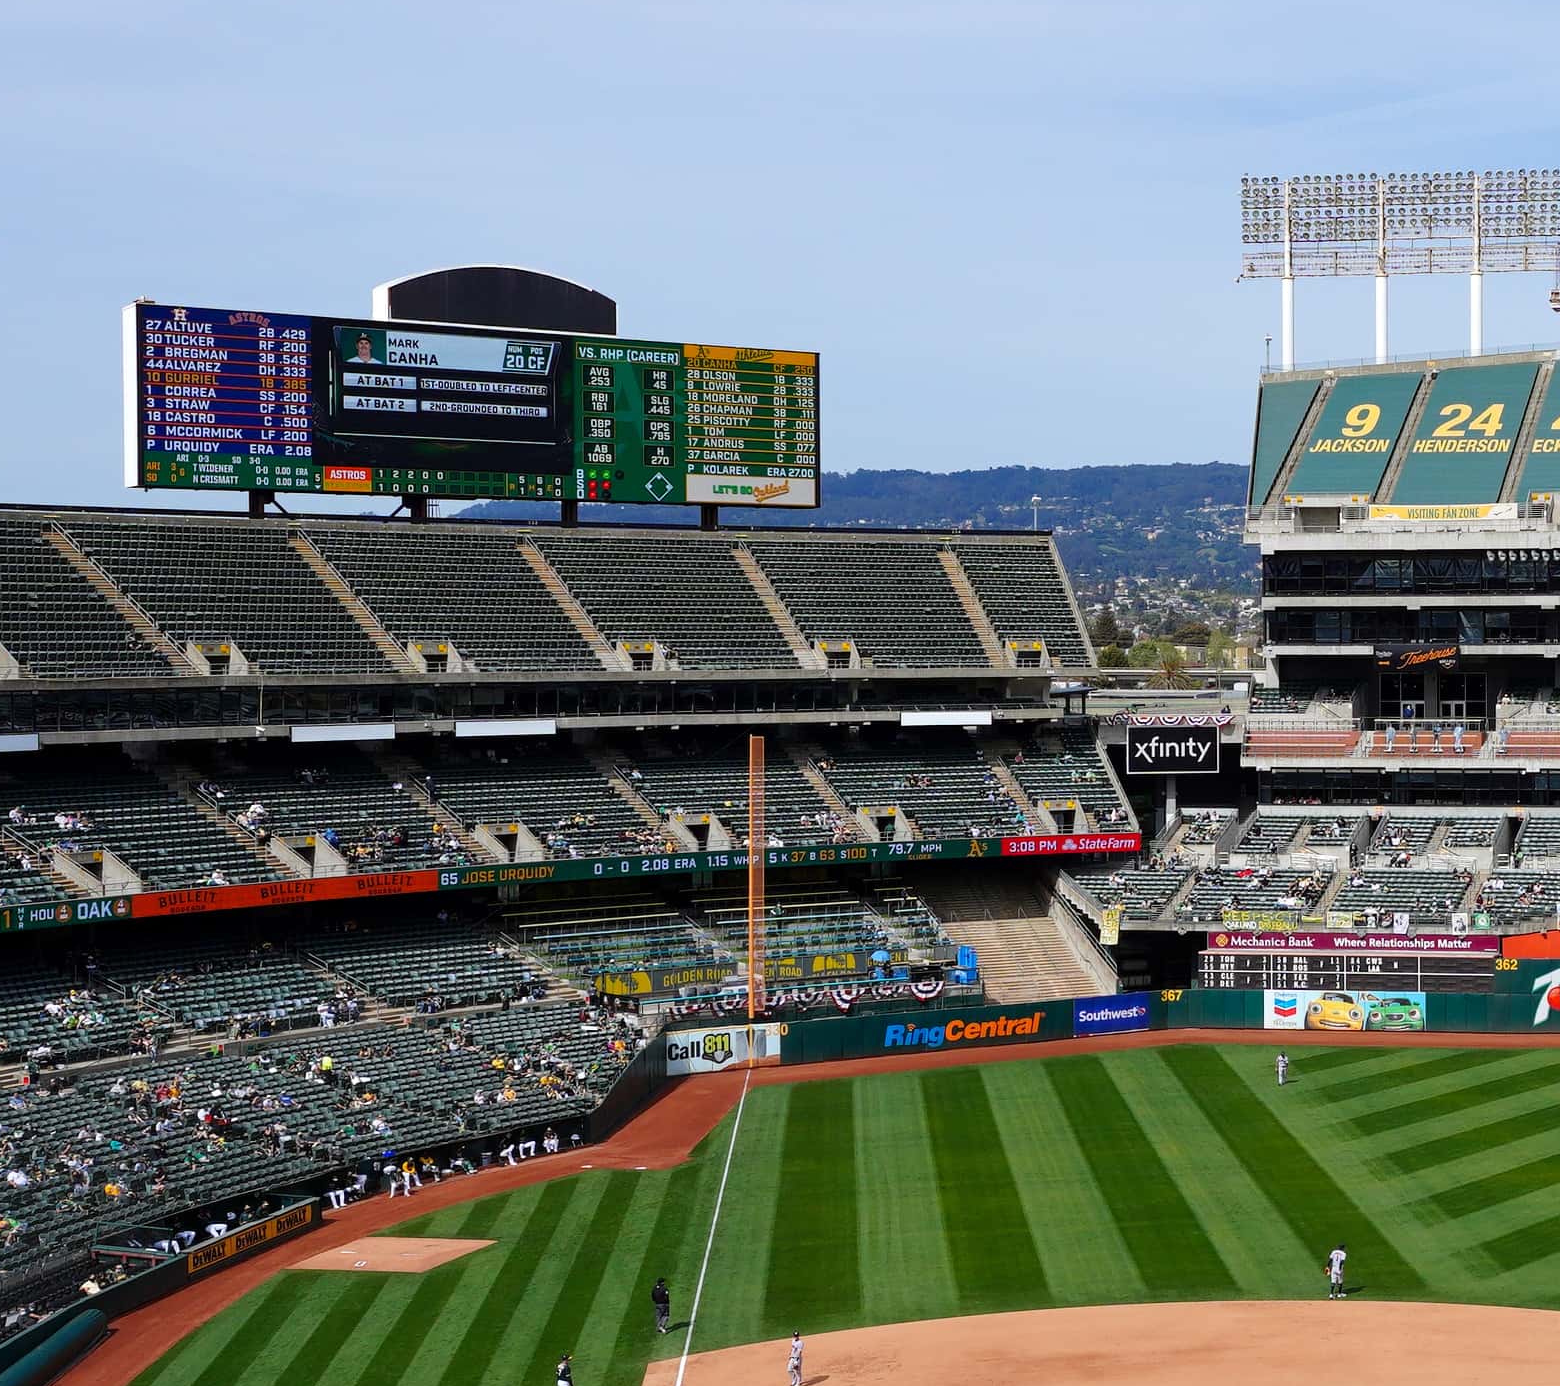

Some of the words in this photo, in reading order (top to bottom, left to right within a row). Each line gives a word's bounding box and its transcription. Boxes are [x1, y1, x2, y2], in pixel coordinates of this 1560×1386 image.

[164, 322, 212, 333] ALTUVE
[165, 334, 215, 347] TUCKER
[388, 338, 419, 349] MARK
[165, 348, 228, 360] BREGMAN
[388, 352, 438, 366] CANHA
[579, 347, 594, 358] VS.
[600, 349, 623, 360] RHP
[165, 361, 221, 373] ALVAREZ
[166, 373, 219, 385] GURRIEL
[703, 370, 736, 381] OLSON
[166, 385, 216, 398] CORREA
[703, 381, 741, 392] LOWRIE
[166, 399, 210, 410] STRAW
[703, 393, 758, 405] MORELAND
[703, 404, 753, 416] CHAPMAN
[166, 412, 215, 424] CASTRO
[703, 415, 750, 427] PISCOTTY
[1341, 403, 1381, 437] 9
[1432, 403, 1505, 437] 24
[166, 427, 243, 439] MCCORMICK
[703, 426, 724, 437] TOM
[164, 440, 220, 453] URQUIDY
[703, 437, 744, 449] ANDRUS
[1309, 438, 1390, 453] JACKSON
[1412, 438, 1511, 453] HENDERSON
[703, 450, 740, 461] GARCIA
[703, 464, 749, 475] KOLAREK
[1407, 508, 1440, 519] VISITING
[1442, 508, 1457, 519] FAN
[1458, 507, 1480, 519] ZONE
[1397, 646, 1457, 669] Treehouse
[1135, 736, 1211, 763] xfinity
[1008, 840, 1036, 853] 3:08
[1039, 839, 1057, 851] PM
[440, 873, 458, 885] 65
[461, 869, 495, 885] JOSE
[499, 865, 555, 882] URQUIDY
[642, 859, 669, 871] 2.08
[674, 857, 696, 869] ERA
[30, 909, 54, 922] HOU
[77, 900, 113, 919] OAK
[1230, 935, 1286, 947] Mechanics
[1288, 935, 1314, 947] Bank
[1333, 937, 1366, 949] Where
[1368, 937, 1435, 950] Relationships
[1437, 938, 1472, 949] Matter
[1495, 958, 1518, 971] 362
[663, 969, 704, 987] GOLDEN
[780, 967, 802, 978] ROAD
[1160, 989, 1183, 1002] 367
[1078, 1006, 1139, 1022] Southwest
[884, 1012, 1041, 1047] RingCentral
[667, 1040, 701, 1061] Call
[703, 1033, 731, 1055] 811
